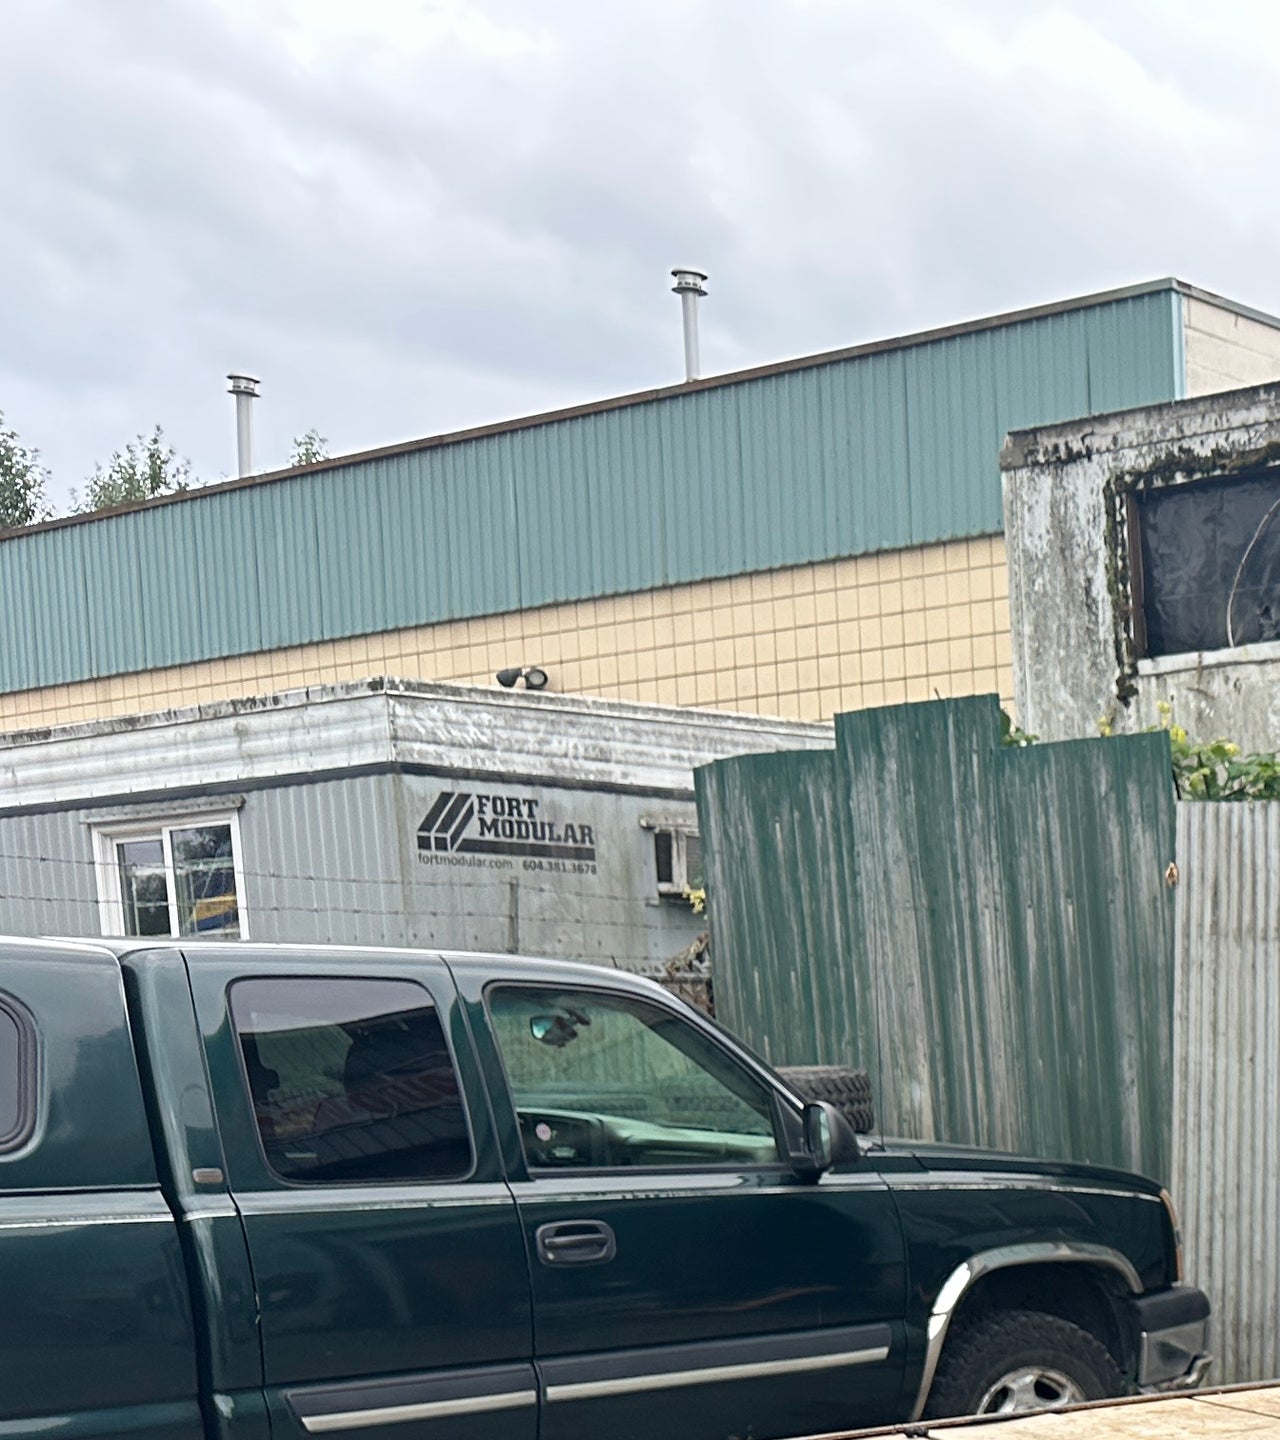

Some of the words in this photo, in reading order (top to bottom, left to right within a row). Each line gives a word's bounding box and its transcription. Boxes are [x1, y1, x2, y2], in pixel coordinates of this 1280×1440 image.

[475, 794, 540, 819] FORT
[478, 817, 594, 845] MODULAR
[418, 853, 514, 870] fortmodular.com
